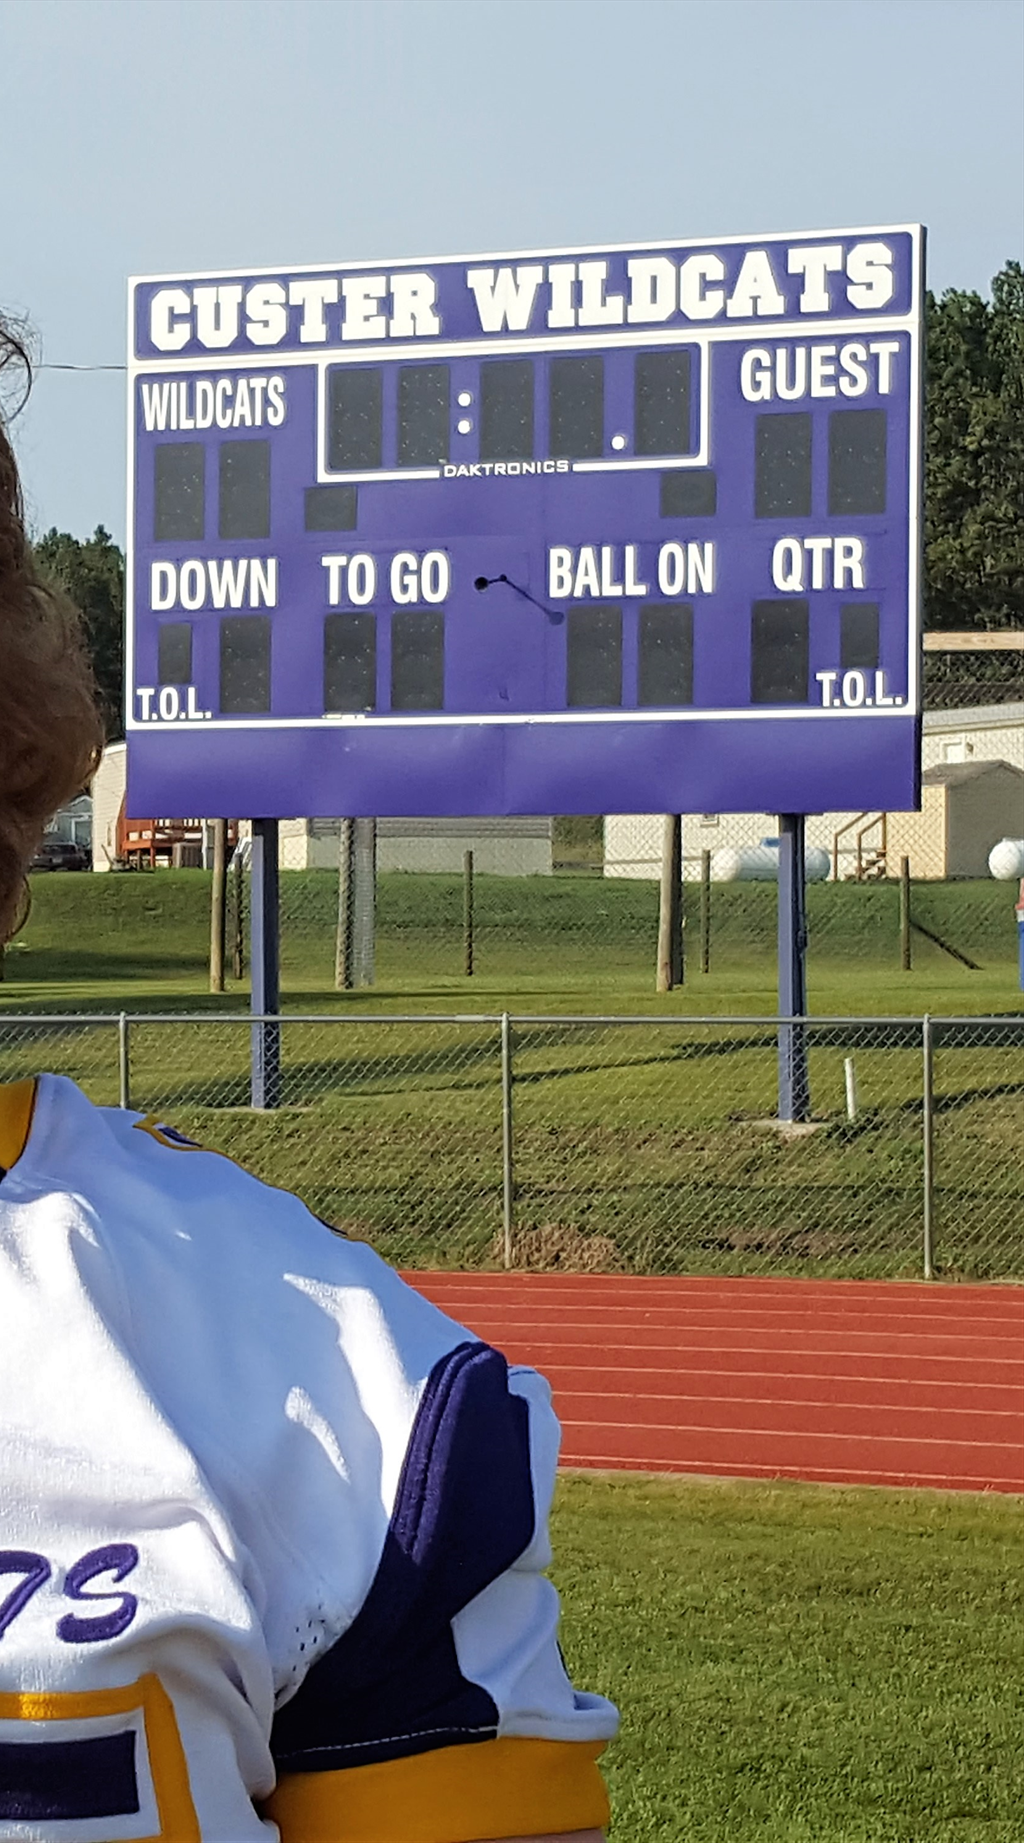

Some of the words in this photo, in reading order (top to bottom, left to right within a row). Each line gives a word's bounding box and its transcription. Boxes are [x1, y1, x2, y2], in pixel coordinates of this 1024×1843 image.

[150, 272, 441, 351] CUSTER
[466, 242, 893, 332] WILDCATS
[740, 341, 900, 402] GUEST
[141, 375, 286, 431] WILDCATS
[443, 459, 570, 478] DAKTRONICS
[150, 558, 277, 611] DOWN
[321, 554, 376, 605] TO
[390, 551, 449, 604] GO
[548, 545, 647, 599] BALL
[657, 541, 714, 596] ON
[772, 536, 865, 592] QTR
[136, 686, 212, 721] T.O.L.
[815, 670, 903, 708] T.O.L.
